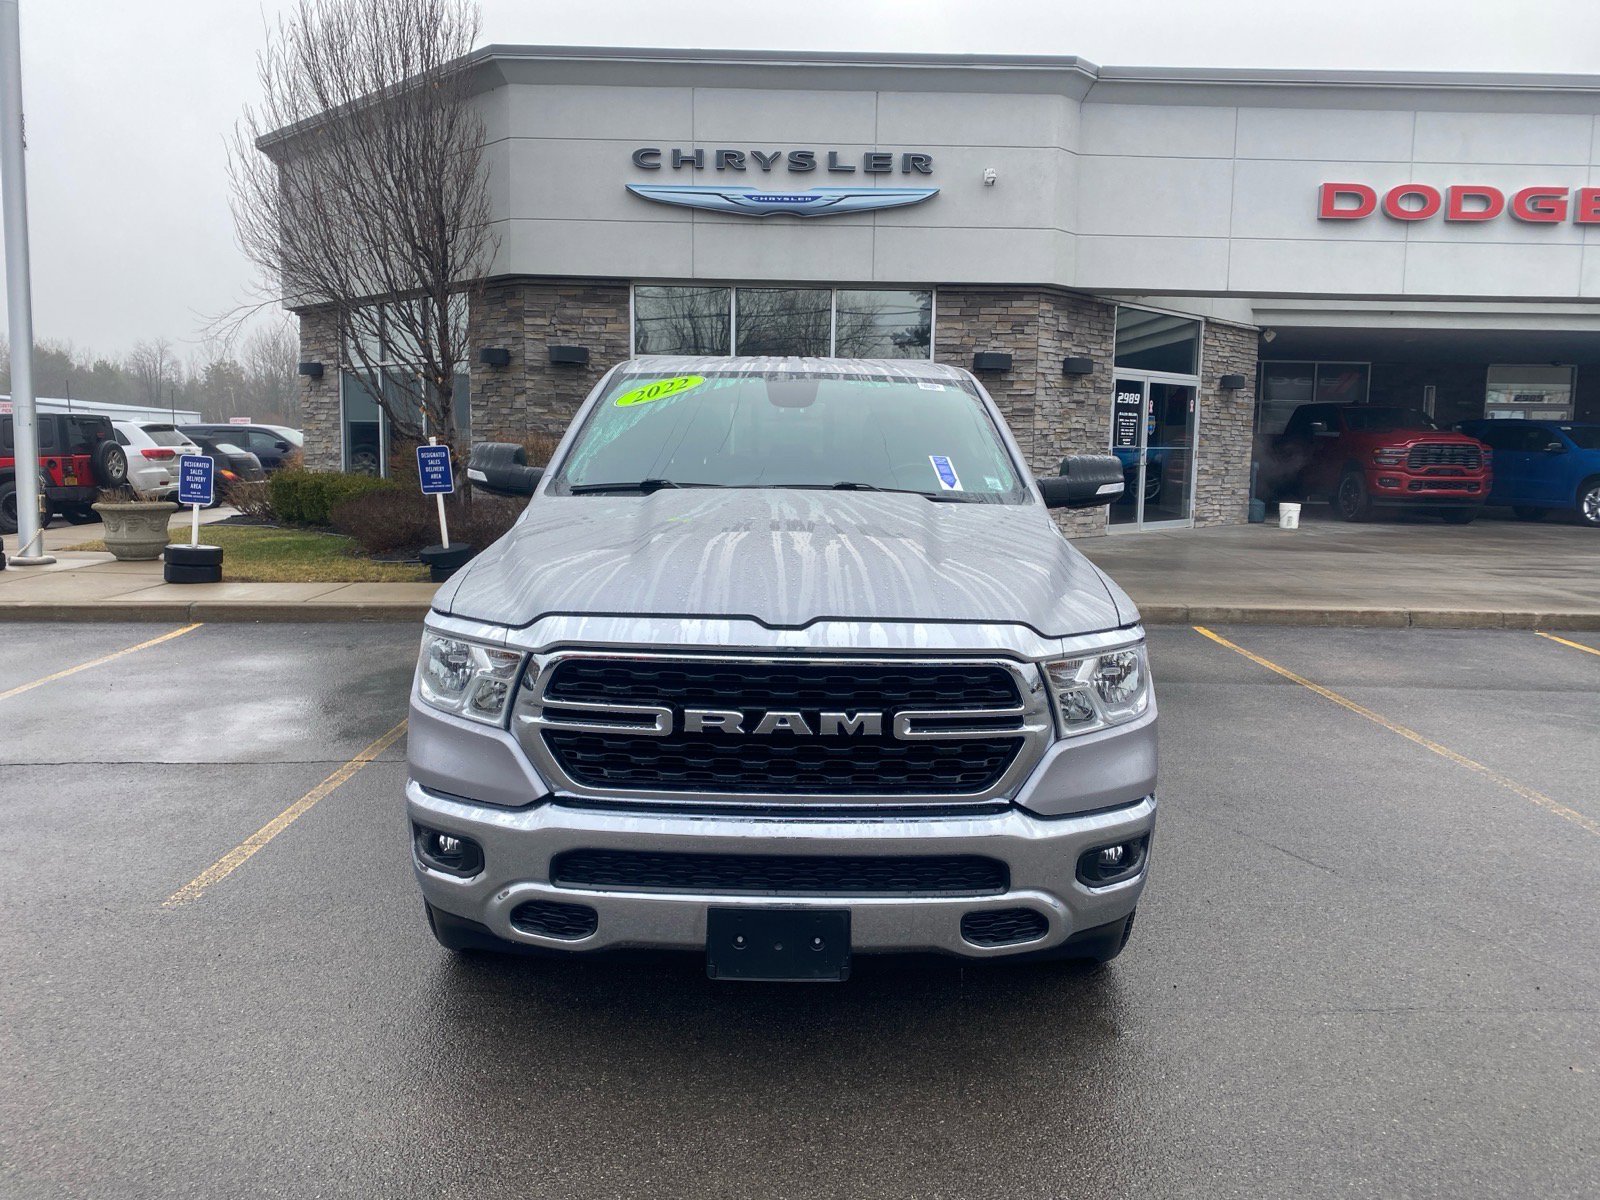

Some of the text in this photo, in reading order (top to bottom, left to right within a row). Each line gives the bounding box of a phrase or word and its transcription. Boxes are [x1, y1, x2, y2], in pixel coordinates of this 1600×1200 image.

[632, 148, 933, 174] CHRYSLER
[632, 378, 689, 403] 2022
[1117, 392, 1140, 404] 2989
[683, 709, 883, 735] RAM
